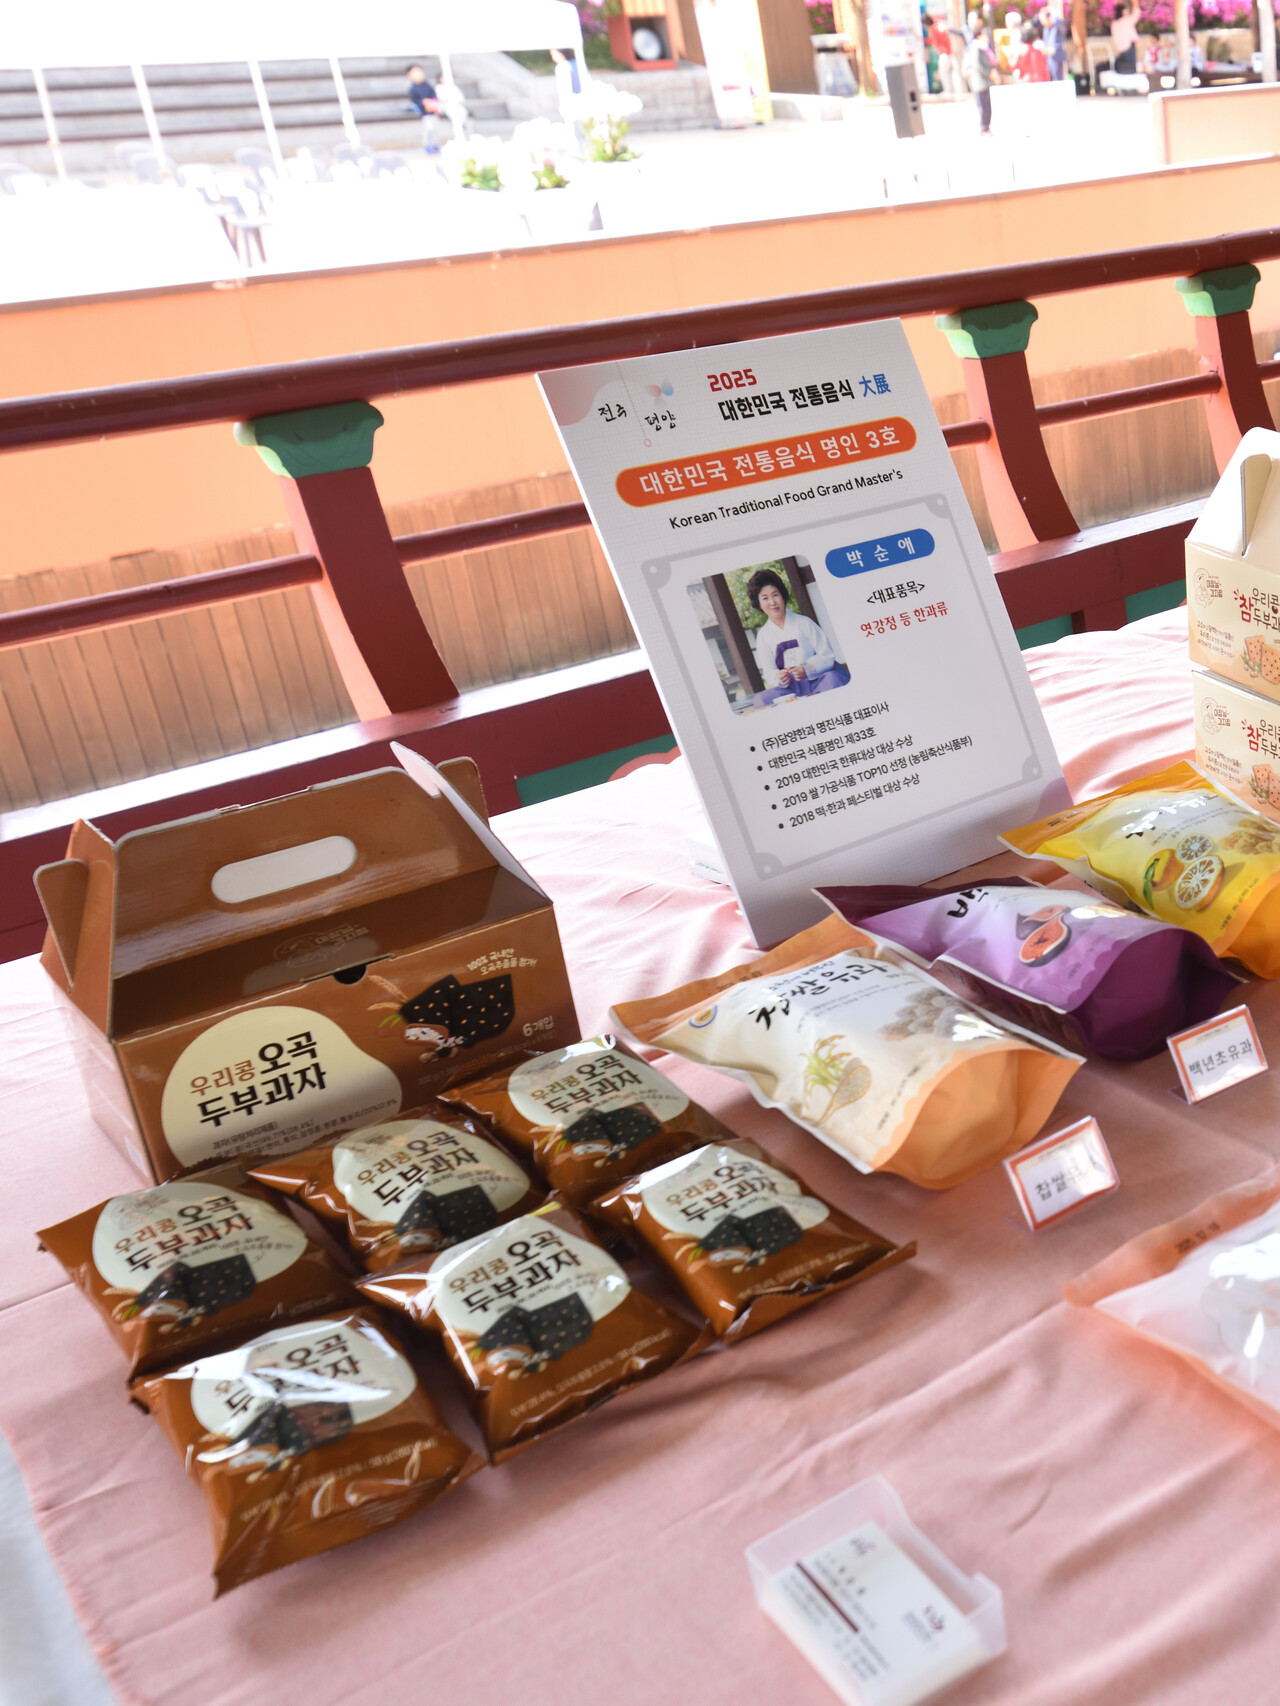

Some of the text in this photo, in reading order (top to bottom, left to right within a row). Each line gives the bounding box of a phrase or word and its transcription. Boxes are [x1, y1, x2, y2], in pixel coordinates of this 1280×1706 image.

[707, 368, 757, 392] 2025
[718, 373, 891, 421] 대한민국 전통음식 大展
[598, 403, 676, 432] 전주 평양
[639, 425, 900, 496] 대한민국 전통음식 명인 3호
[669, 468, 903, 529] Korean Traditional Food Grand Master's
[866, 580, 926, 604] <대표품목>
[1252, 588, 1280, 614] 우리콩
[860, 601, 950, 638] 엿강정 등 한과류
[761, 701, 890, 752] (주)담양한과 명진식품 대표이사
[768, 726, 877, 770] 대한민국 식품명인 제33호
[775, 734, 913, 790] 2019 대한민국 한류대상 대상 수상
[782, 735, 973, 809] 2019 쌀 가공식품 TOP10 선정 (농림축산식품부)
[789, 773, 921, 828] 2018 떡·한과 페스티벌 대상 수상
[522, 1016, 554, 1036] 6개입
[190, 1031, 317, 1096] 우리콩 오곡
[530, 1071, 577, 1102] 우리콩
[576, 1053, 627, 1082] 오곡
[1188, 1039, 1254, 1076] 백년초유과
[197, 1062, 326, 1127] 두부과자
[543, 1070, 644, 1116] 두부과자
[357, 1127, 461, 1186] 우리콩 오곡
[372, 1148, 482, 1208] 두부과자
[665, 1159, 766, 1207] 우리콩 오곡
[681, 1171, 778, 1223] 두부과자
[114, 1218, 176, 1256] 우리콩
[177, 1194, 240, 1230] 오곡
[124, 1213, 255, 1273] 두부과자
[448, 1228, 566, 1296] 우리콩 오곡
[462, 1249, 582, 1315] 두부과자
[285, 1334, 349, 1370] 오곡
